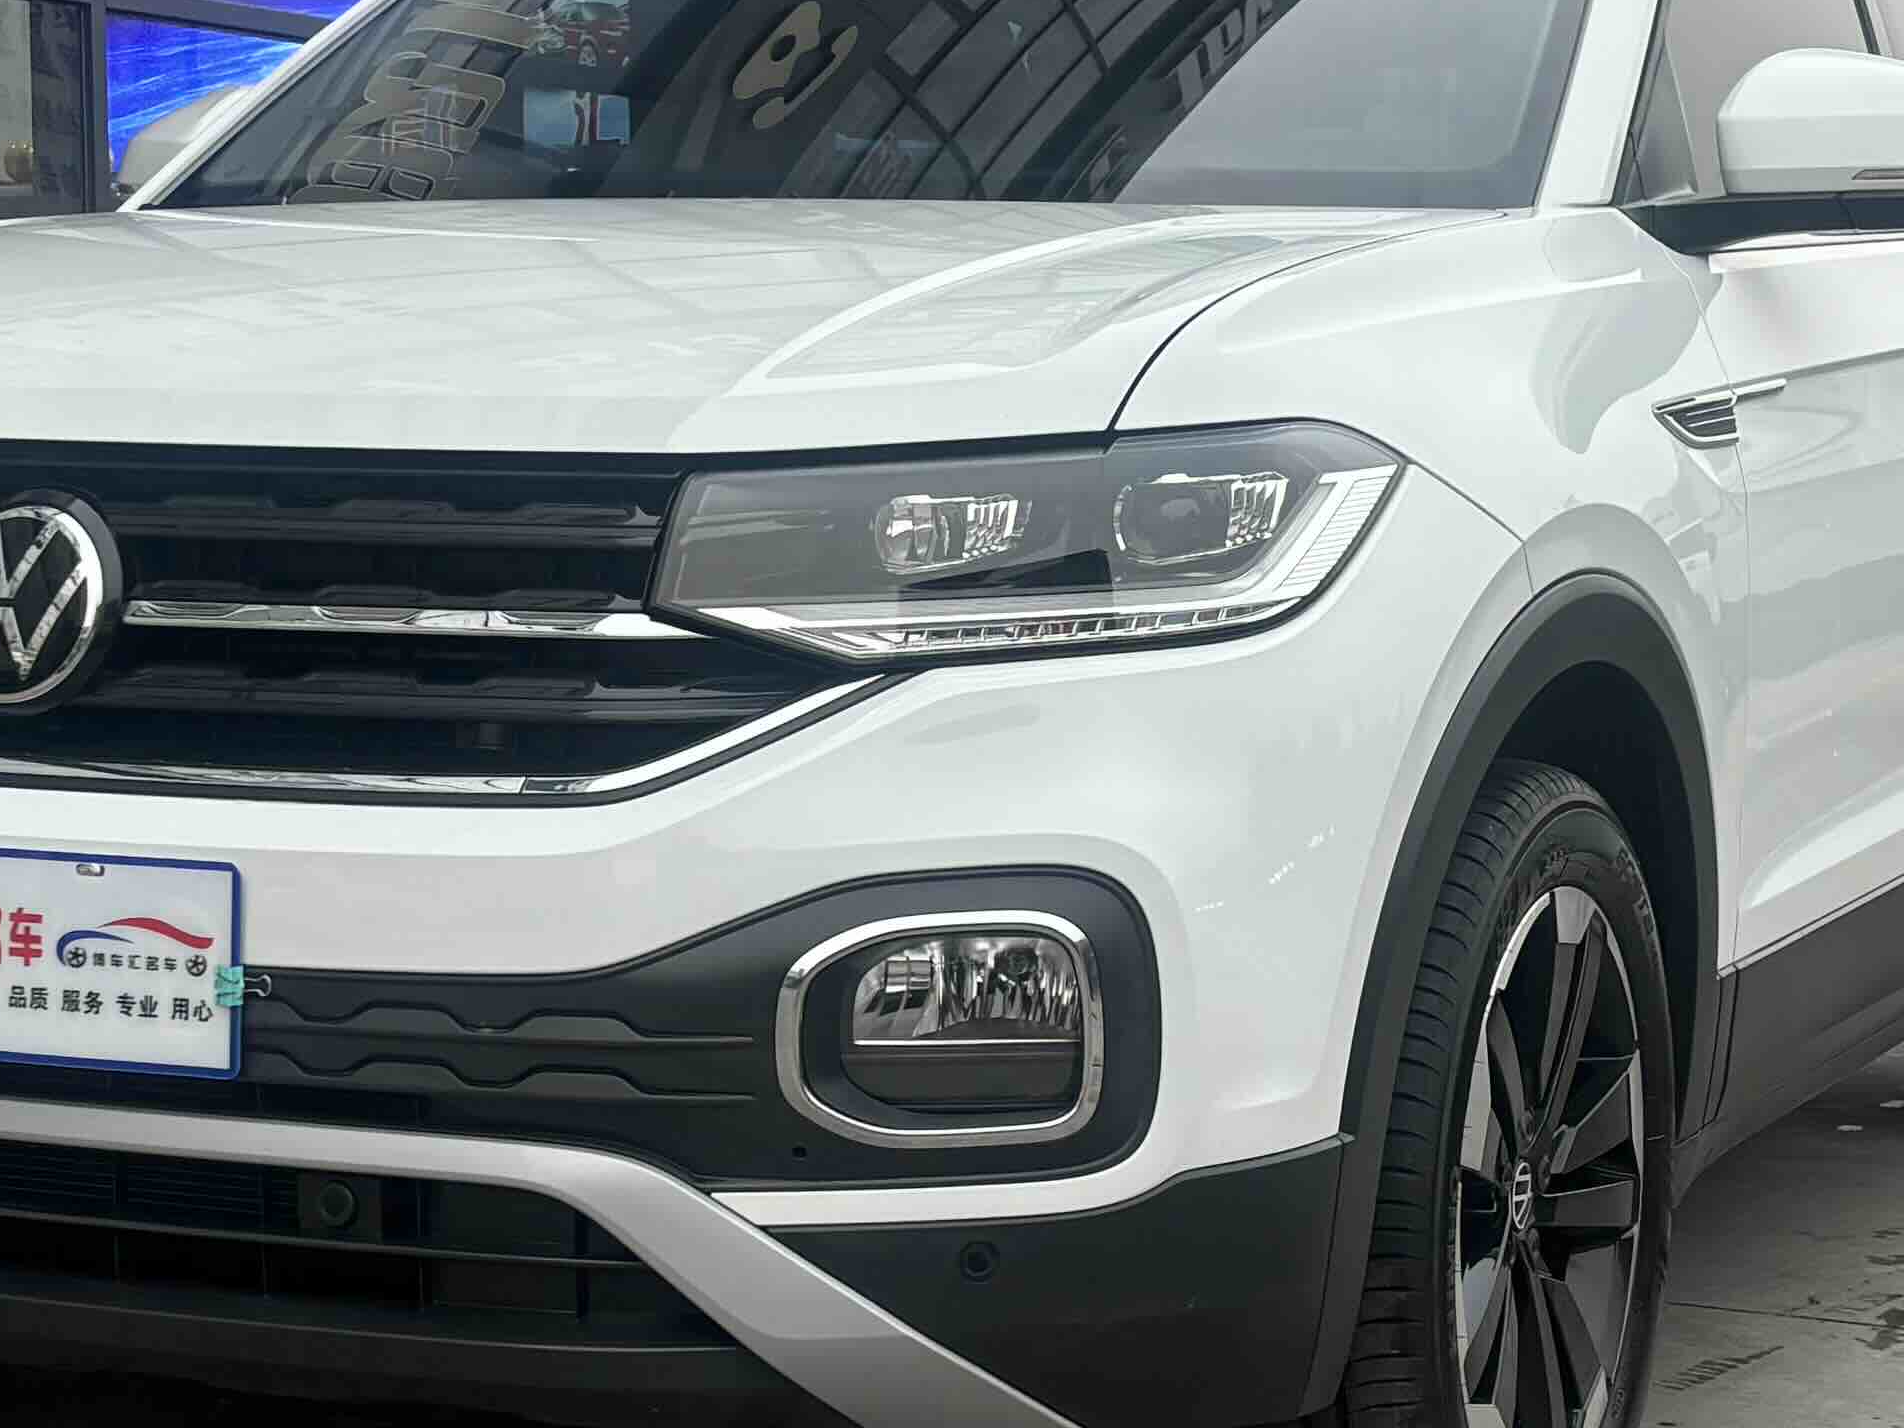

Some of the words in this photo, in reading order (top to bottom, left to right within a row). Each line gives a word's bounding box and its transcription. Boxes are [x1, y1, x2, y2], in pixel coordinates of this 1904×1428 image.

[8, 985, 49, 1010] 品质
[61, 989, 103, 1015] 服务
[116, 994, 158, 1019] 专业
[171, 998, 214, 1022] 用心
